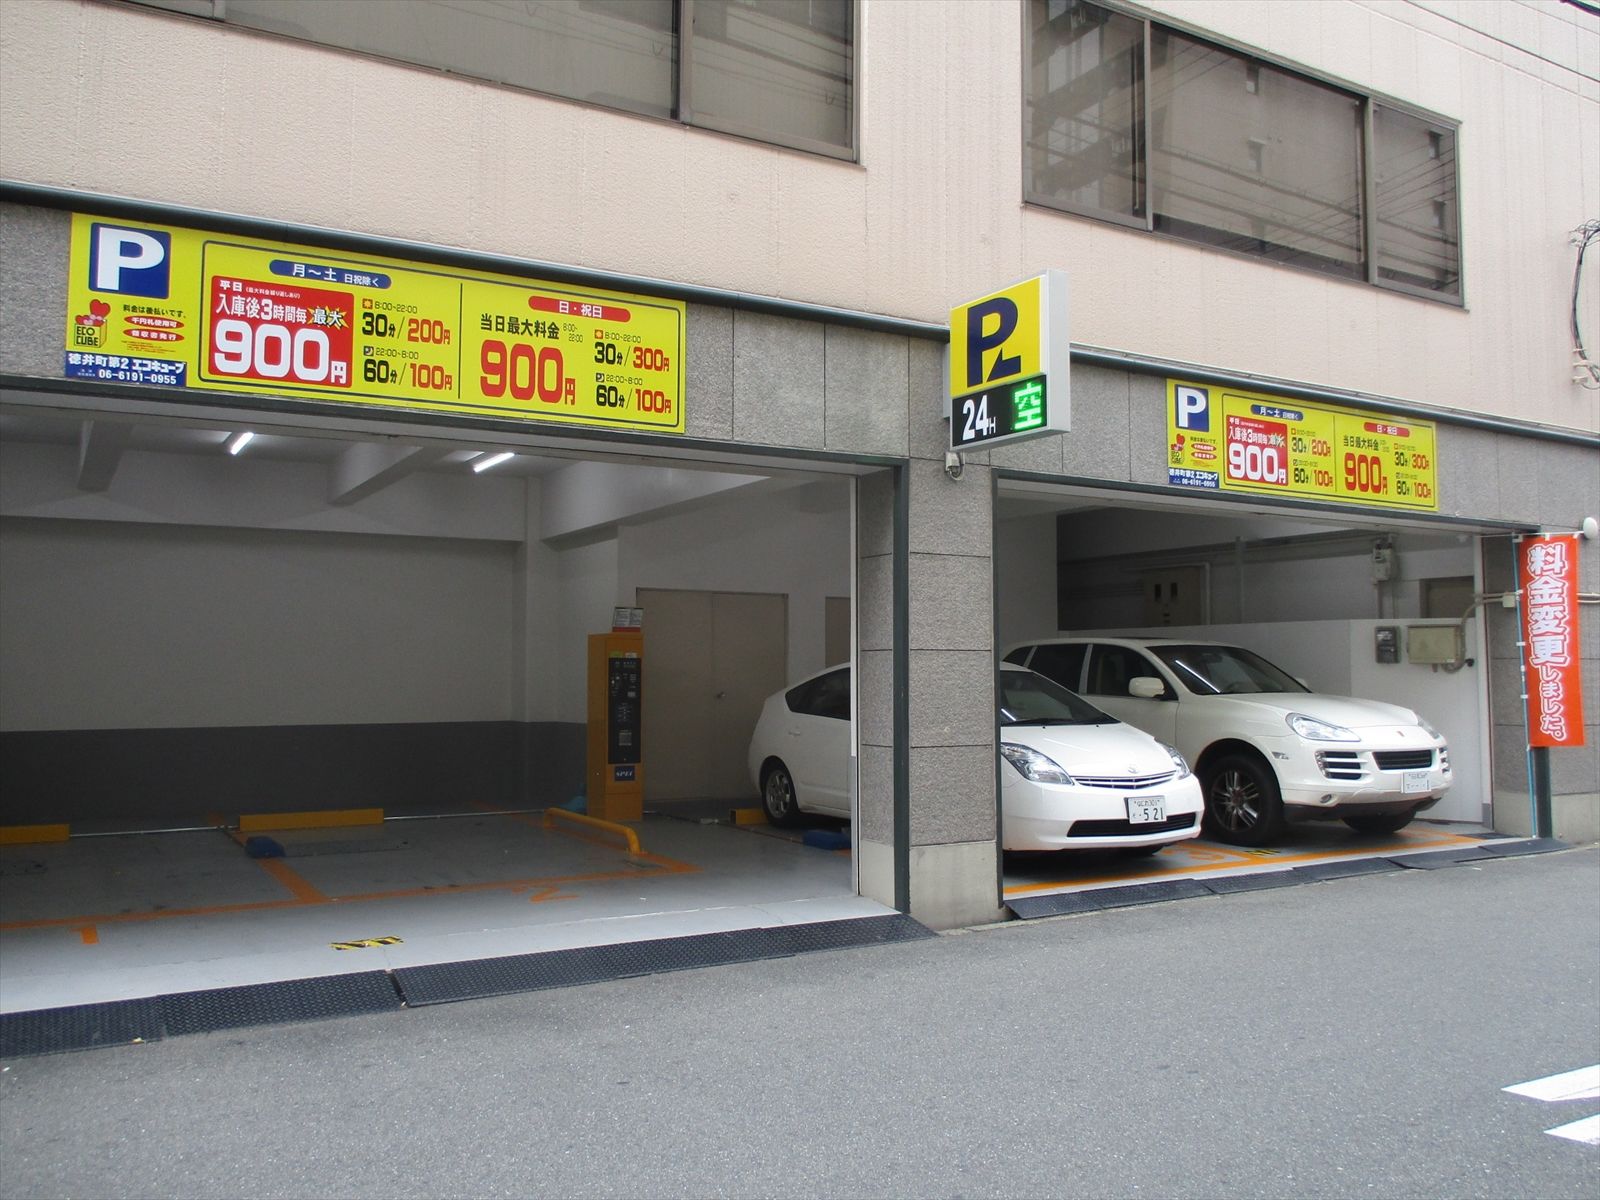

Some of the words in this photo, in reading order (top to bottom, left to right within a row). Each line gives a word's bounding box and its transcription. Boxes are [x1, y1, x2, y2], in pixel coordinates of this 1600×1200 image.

[96, 226, 165, 291] P
[219, 280, 243, 293] 平日
[344, 273, 379, 288] 日祝除く
[131, 317, 178, 328] 千円札使用可
[216, 293, 307, 324] 入庫後3時間毎
[312, 308, 343, 327] 最大
[480, 313, 560, 340] 当日最大料金
[130, 330, 177, 341] 領収書発行
[214, 319, 348, 385] 900円
[68, 352, 129, 370] 徳井町第2
[132, 359, 186, 375] エコキューブ
[98, 369, 177, 385] 06-6191-0955
[480, 339, 576, 406] 900円
[962, 395, 996, 441] 24H
[1014, 382, 1042, 430] 空
[1177, 386, 1206, 428] P
[1343, 435, 1380, 452] 当日最大料金
[1228, 442, 1286, 484] 900円
[1344, 452, 1388, 495] 900円
[1527, 542, 1570, 741] 料金変更しました。
